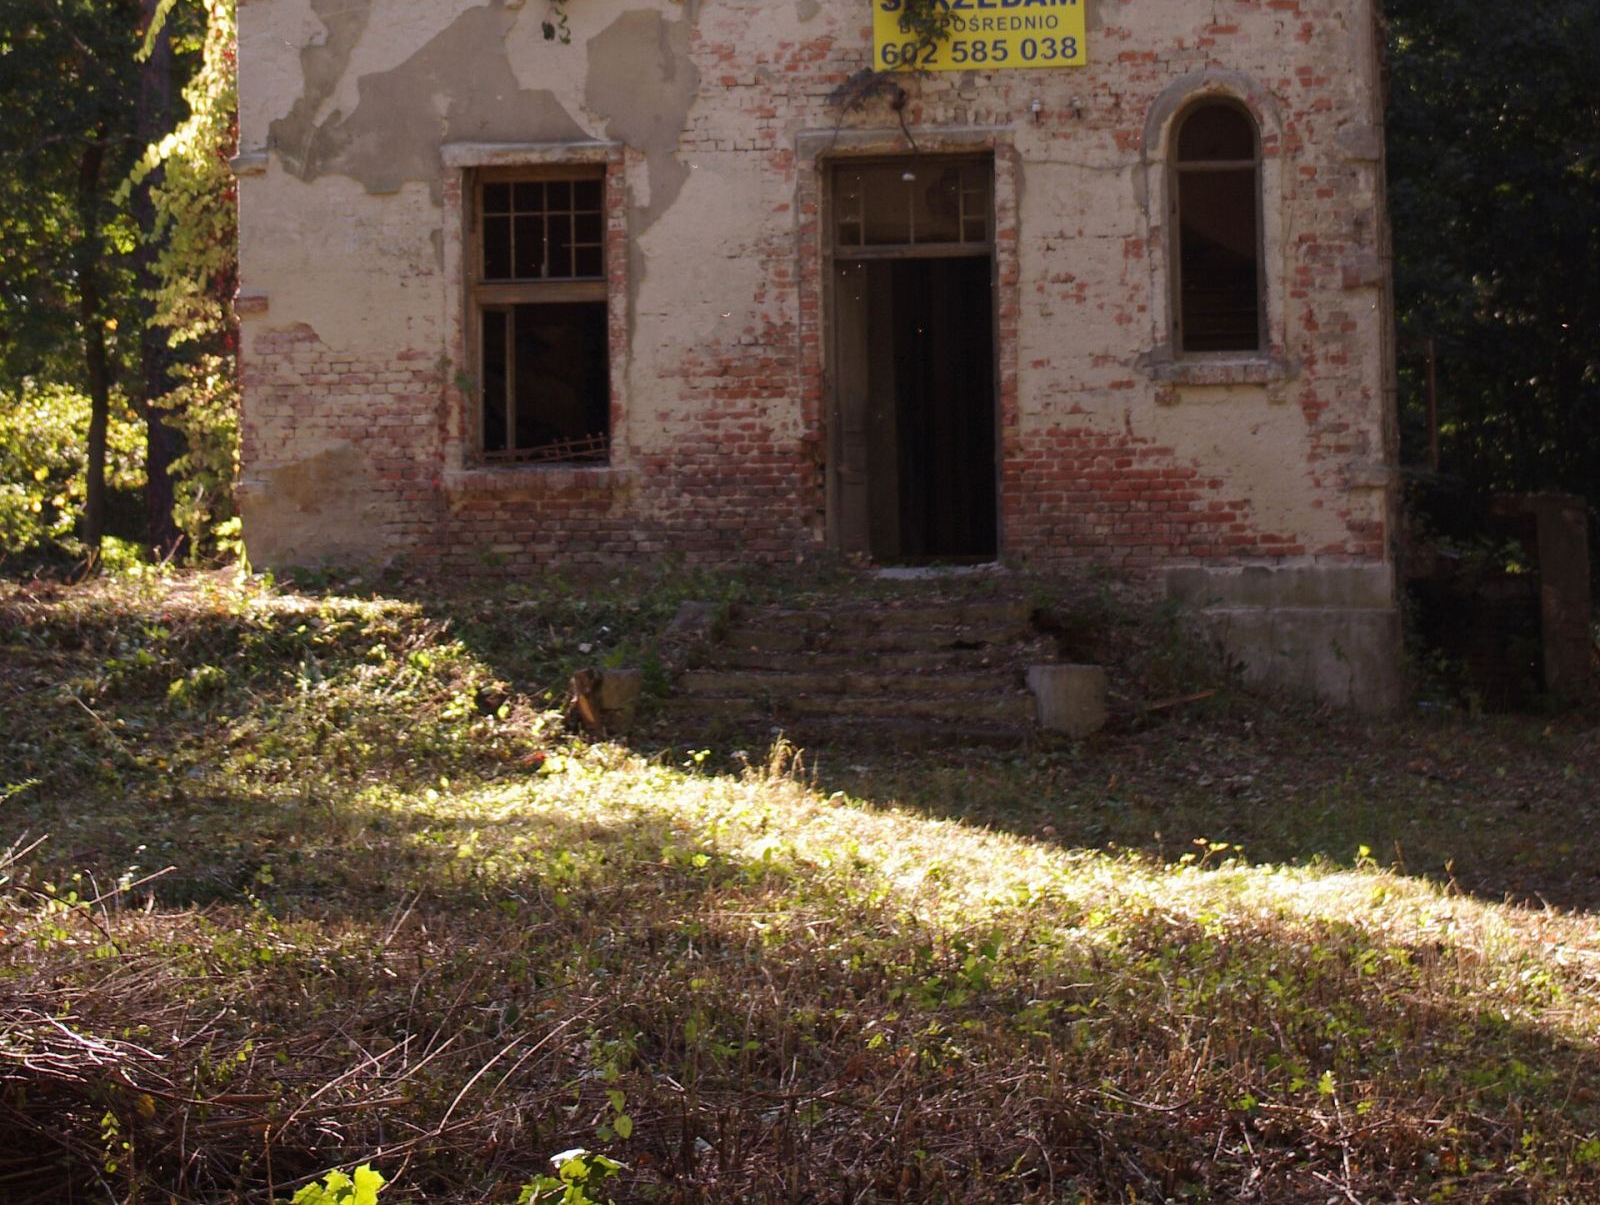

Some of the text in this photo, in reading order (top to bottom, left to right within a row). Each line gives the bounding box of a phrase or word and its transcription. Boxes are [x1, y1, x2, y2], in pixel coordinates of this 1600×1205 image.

[899, 14, 1059, 35] POŚREDNIO
[881, 36, 1078, 65] 602 585 038
